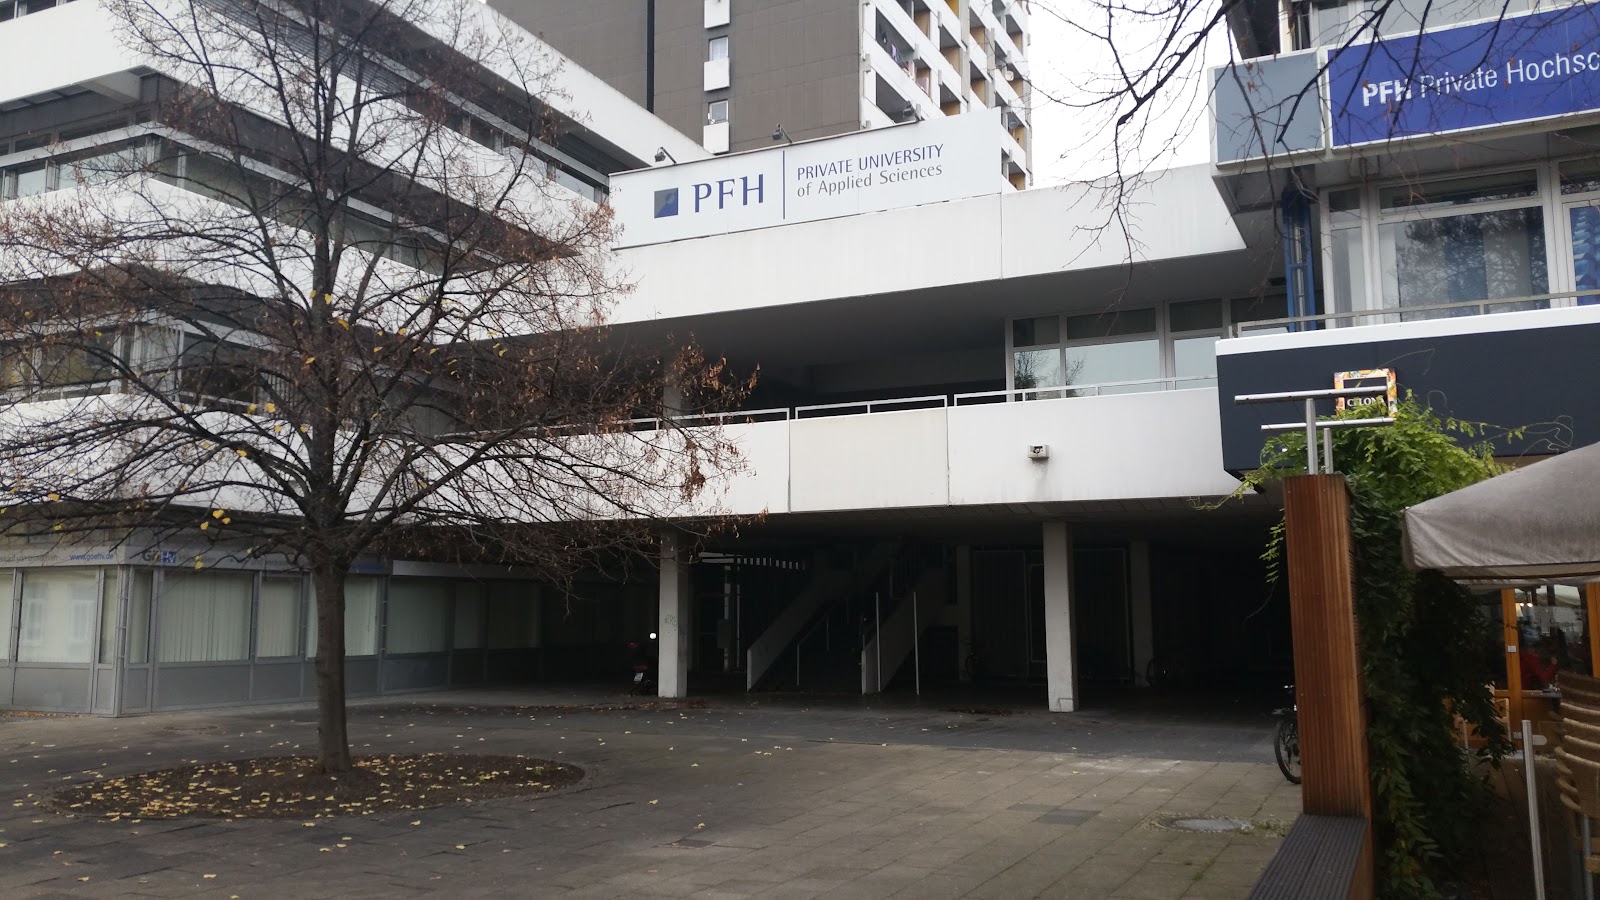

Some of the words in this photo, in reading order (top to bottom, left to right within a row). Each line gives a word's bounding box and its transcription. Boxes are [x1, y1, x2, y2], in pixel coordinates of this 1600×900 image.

[1362, 78, 1412, 107] PFH
[1420, 67, 1498, 98] Private
[1506, 52, 1600, 84] Hochsc
[797, 159, 853, 181] PRIVATE
[859, 143, 944, 170] UNIVERSITY
[797, 182, 812, 198] of
[818, 173, 872, 196] Applied
[880, 163, 943, 185] Sciences
[691, 173, 764, 213] PFH
